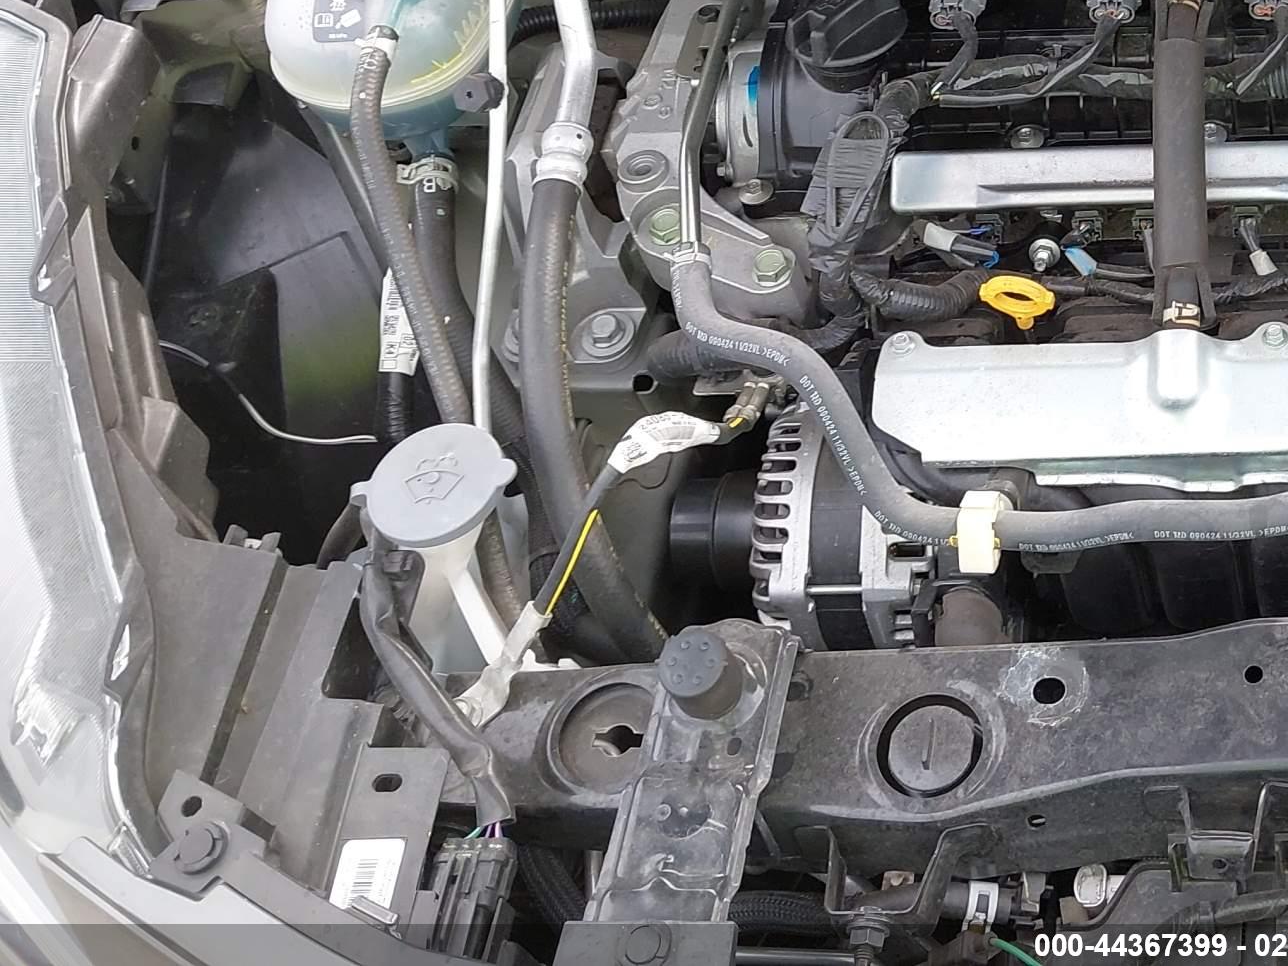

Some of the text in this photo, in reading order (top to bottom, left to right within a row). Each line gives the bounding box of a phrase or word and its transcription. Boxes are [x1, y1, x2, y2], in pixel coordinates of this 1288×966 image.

[799, 375, 815, 392] DOT
[874, 510, 889, 525] DOT
[1153, 530, 1170, 538] DOT
